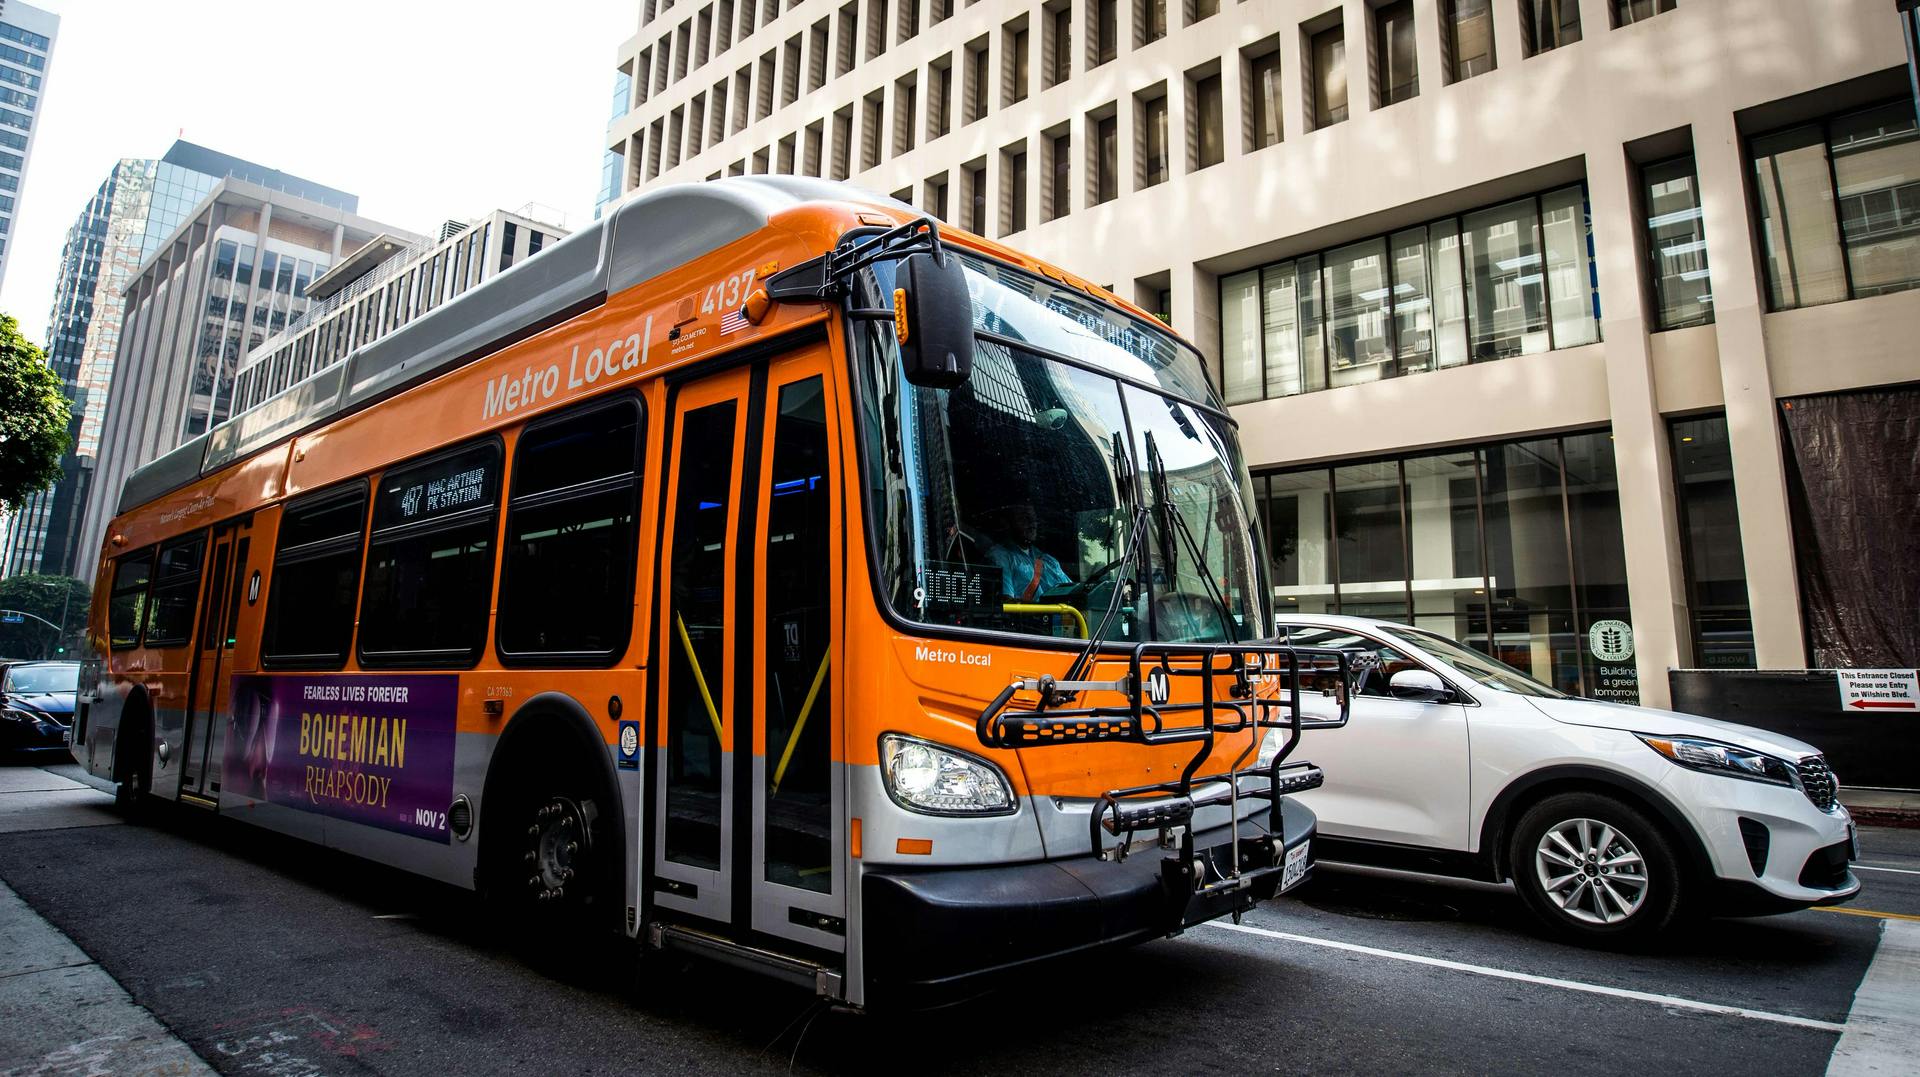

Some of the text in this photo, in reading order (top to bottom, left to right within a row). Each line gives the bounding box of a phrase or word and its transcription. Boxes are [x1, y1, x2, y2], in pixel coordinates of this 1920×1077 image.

[701, 268, 756, 315] 4137
[1139, 336, 1158, 364] PK
[482, 315, 653, 421] Metro Local
[427, 467, 485, 496] MAC ARTHUR
[401, 484, 424, 517] 487
[427, 483, 482, 511] PK STATION
[249, 575, 261, 601] M
[913, 587, 925, 608] 9
[915, 646, 991, 667] Metro Local
[1600, 666, 1637, 678] Building
[1611, 678, 1638, 687] green
[1849, 681, 1873, 689] Please
[1888, 681, 1908, 689] Entry
[303, 685, 409, 703] FEARLESS LIVES FOREVER
[1150, 672, 1167, 701] M
[1594, 688, 1639, 696] tomorrow
[1860, 690, 1890, 698] Wilshire
[299, 712, 407, 769] BOHEMIAN
[304, 765, 392, 808] RHAPSODY
[415, 808, 438, 829] NOV
[438, 812, 446, 830] 2
